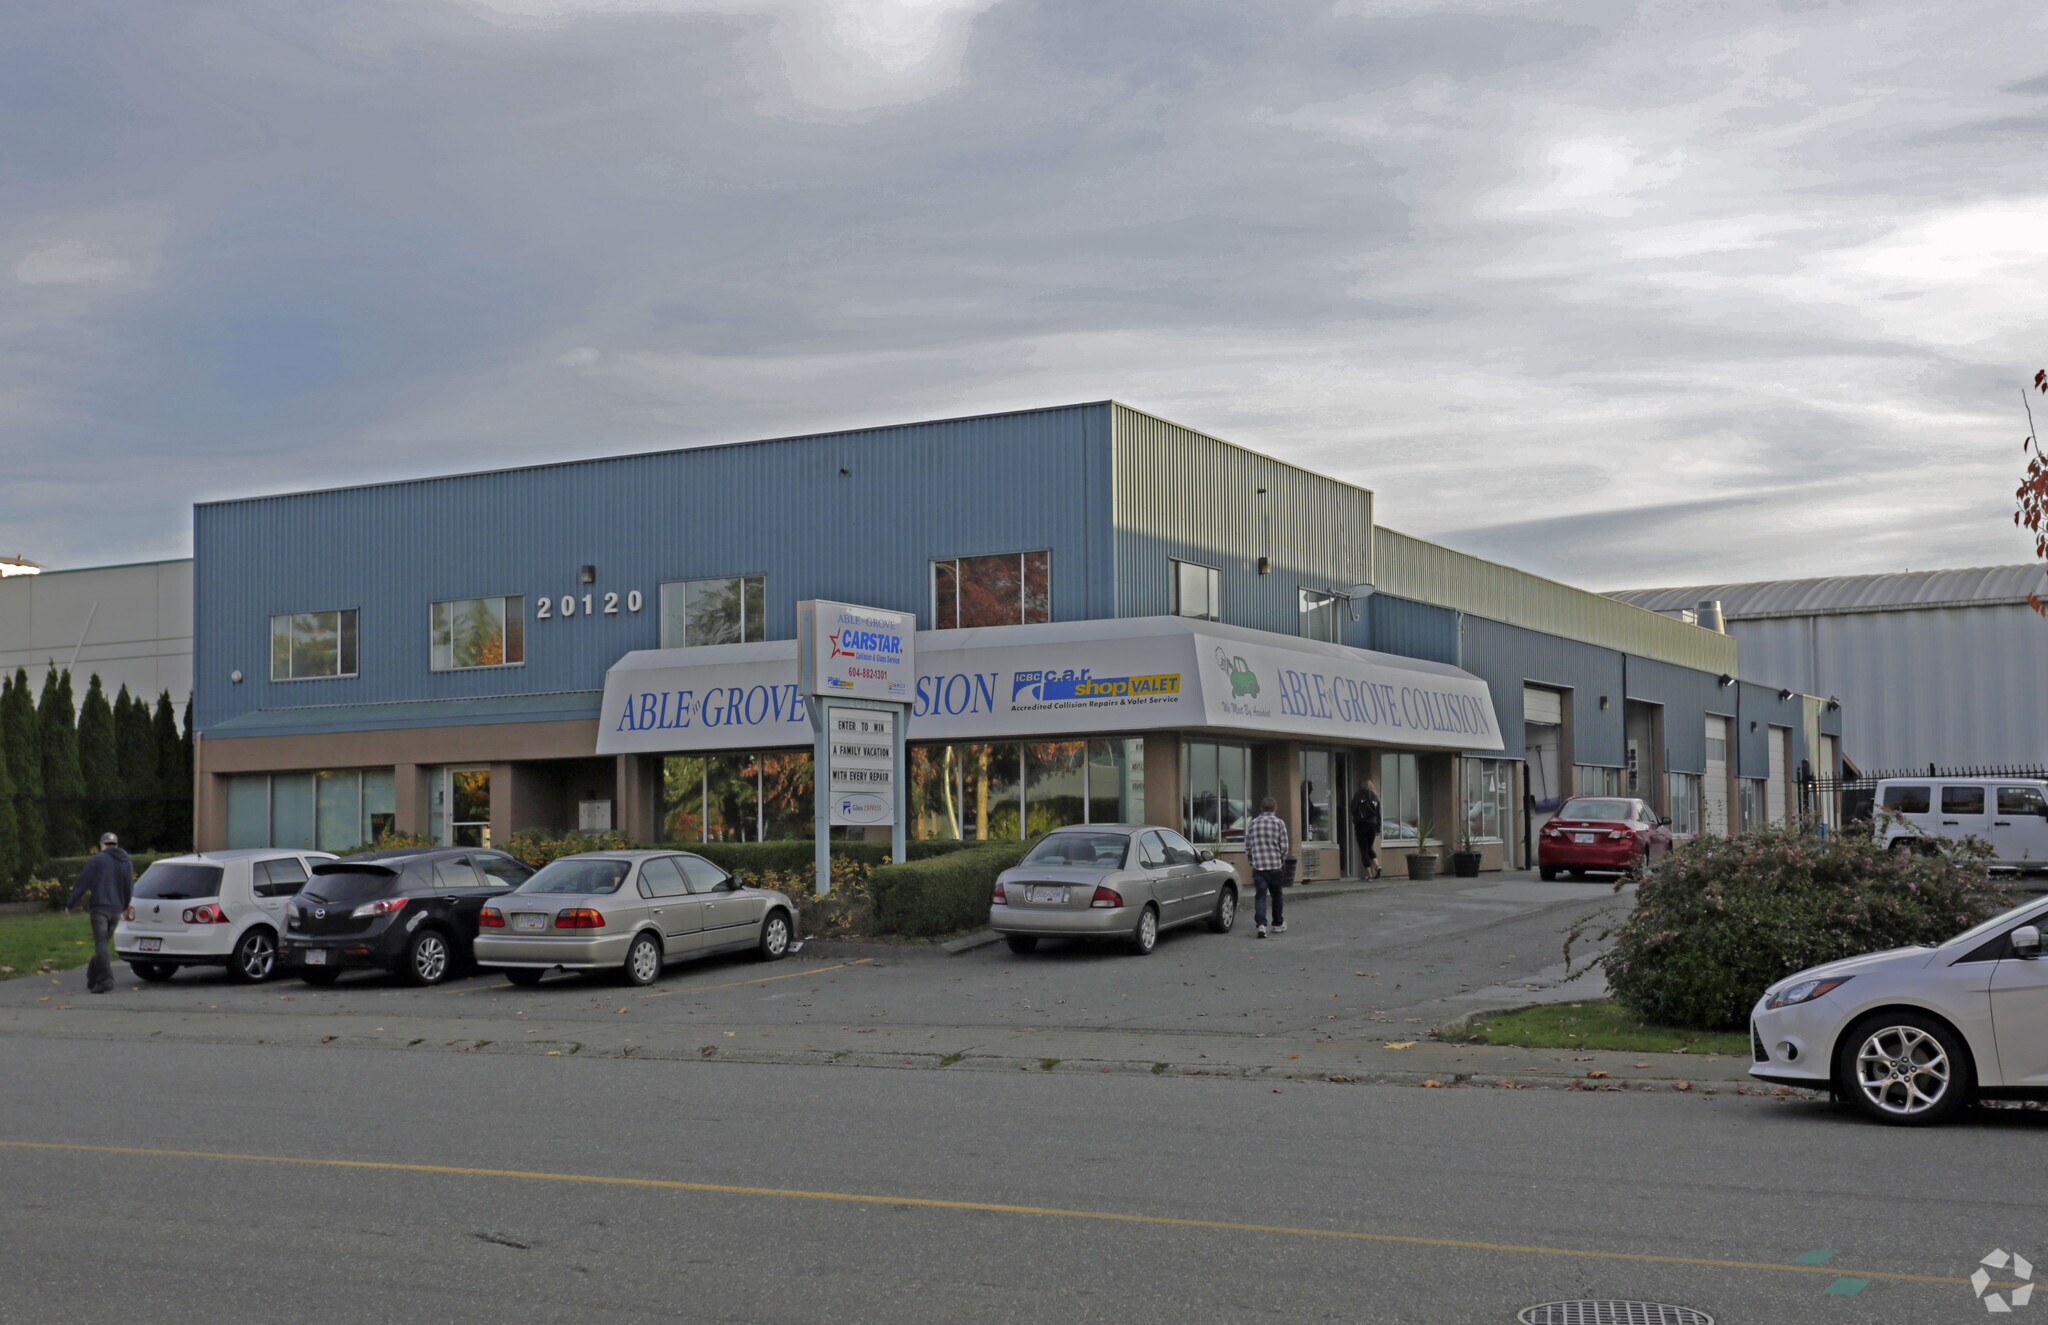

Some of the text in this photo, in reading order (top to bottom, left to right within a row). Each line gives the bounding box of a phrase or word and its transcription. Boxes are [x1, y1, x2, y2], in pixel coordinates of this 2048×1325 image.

[537, 590, 643, 619] 20120
[837, 613, 860, 626] ABLE
[865, 616, 896, 630] GROVE
[842, 629, 901, 654] CARSTAR
[848, 666, 887, 680] 604-882-1301
[1016, 674, 1041, 682] ICBC
[1074, 679, 1127, 697] shop
[1131, 677, 1178, 692] VALET
[616, 690, 694, 732] ABLE
[701, 684, 806, 728] GROVE
[1011, 703, 1052, 712] Accredited
[1054, 702, 1087, 710] Collision
[1089, 700, 1118, 708] Repairs
[1127, 697, 1147, 705] Valet
[1149, 696, 1179, 704] Service
[1277, 667, 1333, 719] ABLE
[1333, 676, 1402, 728] GROVE
[1401, 686, 1491, 736] COLLISION
[838, 720, 885, 733] ENTER TO WIN
[833, 745, 889, 758] A FAMILY VACATION
[832, 770, 889, 782] WITH EVERY REPAIR
